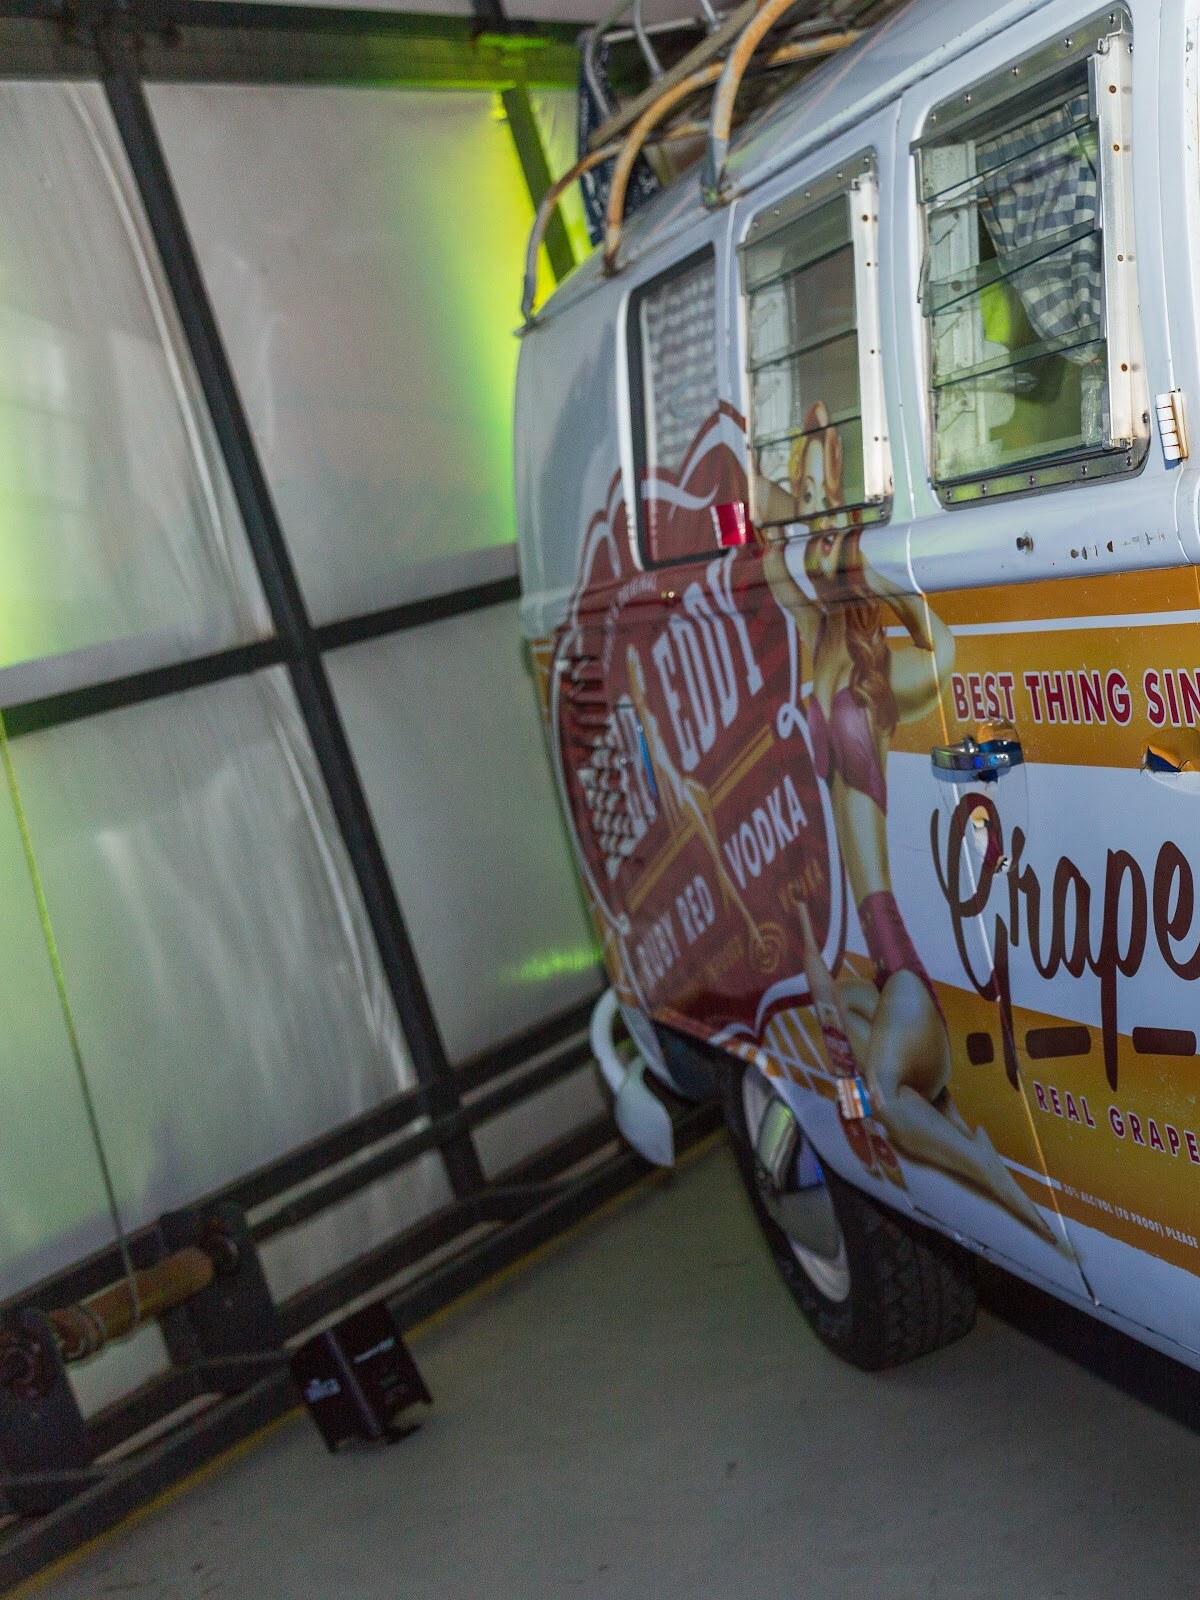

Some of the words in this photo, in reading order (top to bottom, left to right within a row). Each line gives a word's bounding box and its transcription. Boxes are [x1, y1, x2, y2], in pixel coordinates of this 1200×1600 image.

[652, 550, 764, 772] EDDY
[951, 672, 1015, 725] BEST
[1024, 668, 1131, 727] THING
[675, 874, 716, 944] RED
[723, 774, 808, 890] VODKA
[1033, 1081, 1096, 1129] REAL
[1165, 1226, 1199, 1249] PLEASE
